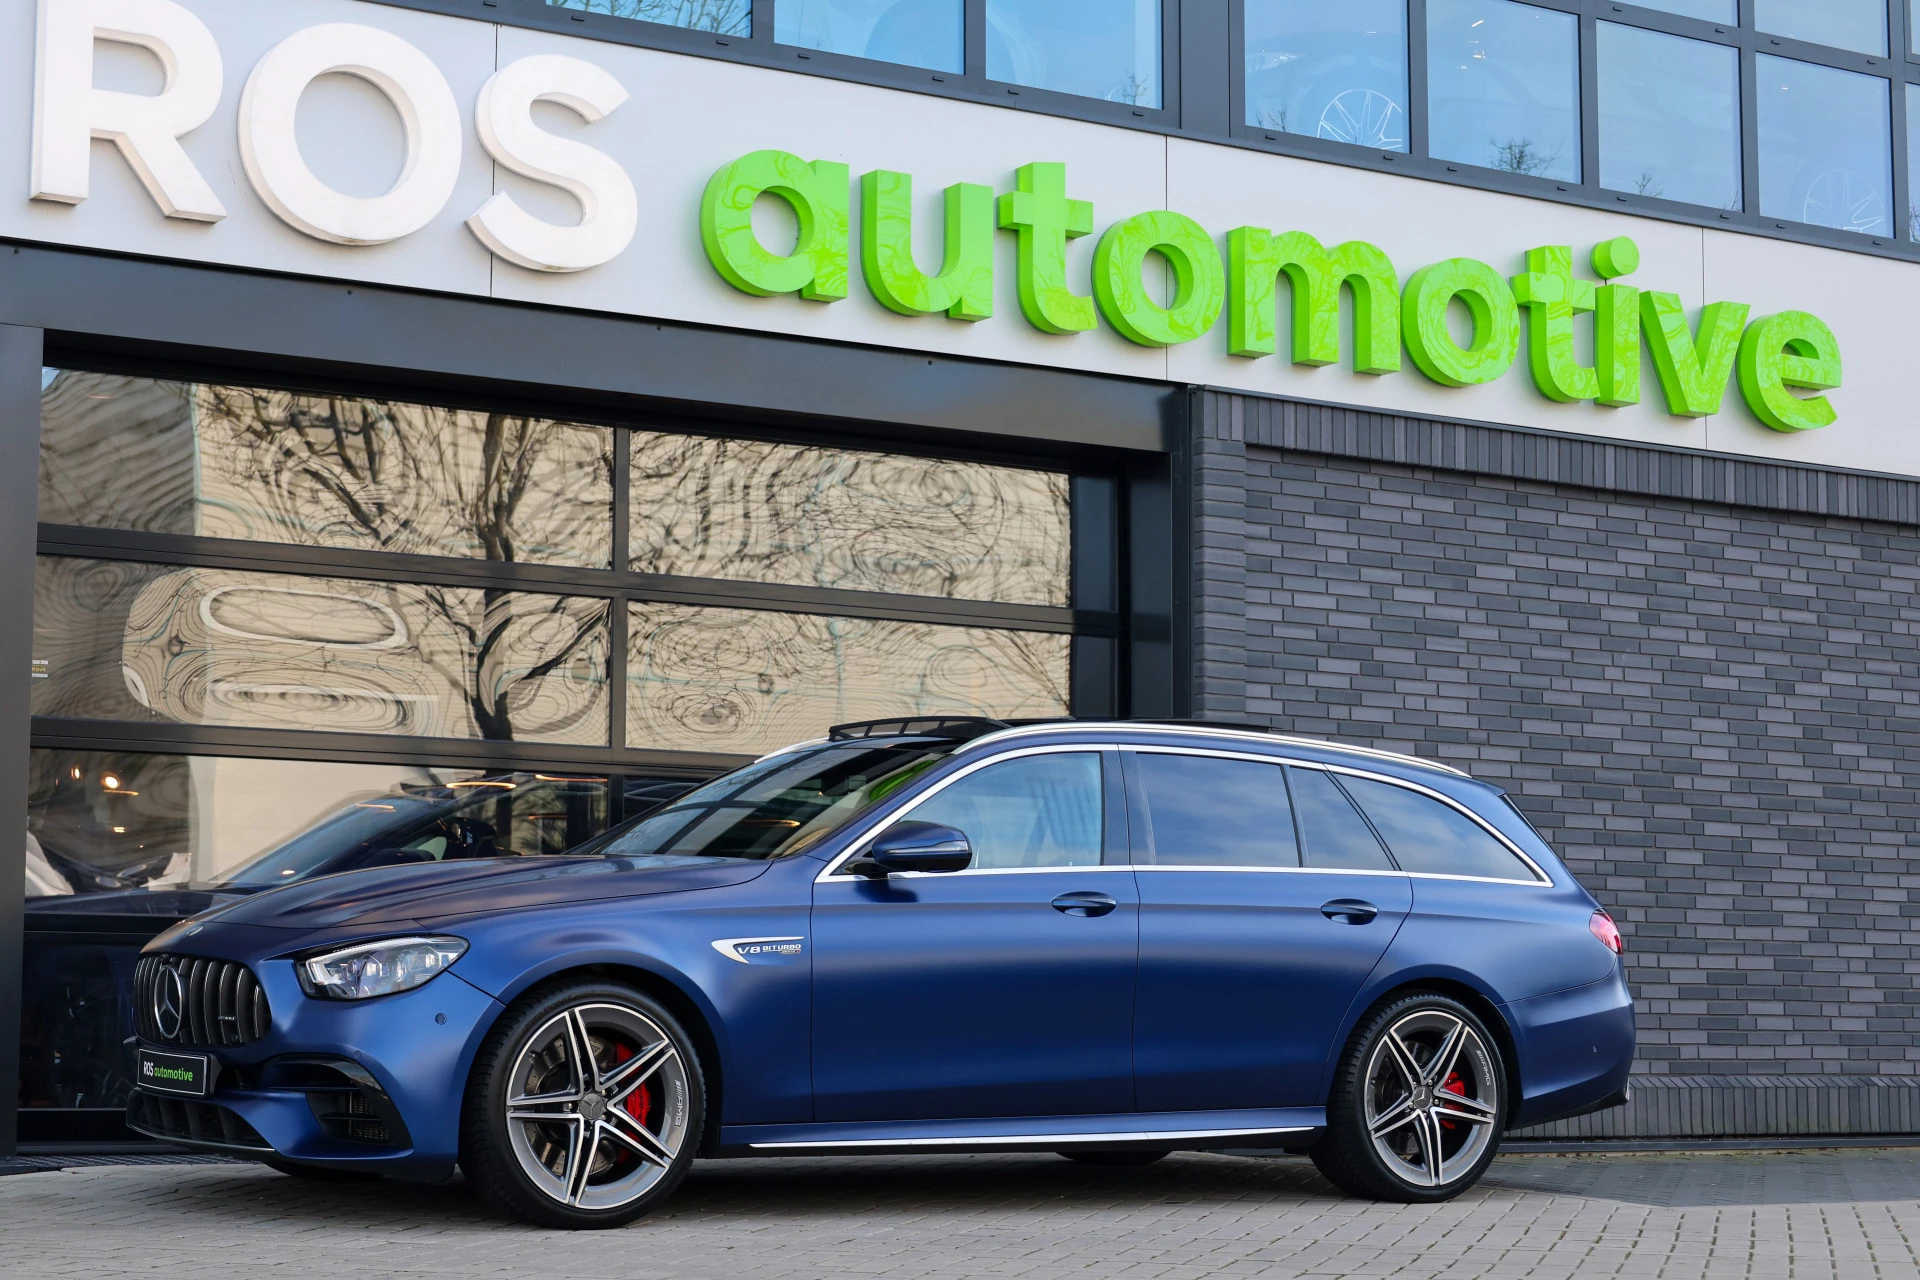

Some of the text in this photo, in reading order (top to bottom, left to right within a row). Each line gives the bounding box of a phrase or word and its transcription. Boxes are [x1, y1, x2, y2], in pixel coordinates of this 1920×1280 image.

[29, 0, 1842, 433] ROS automotive
[737, 943, 802, 955] V8 BITURBO
[143, 1061, 193, 1081] ROS automotive
